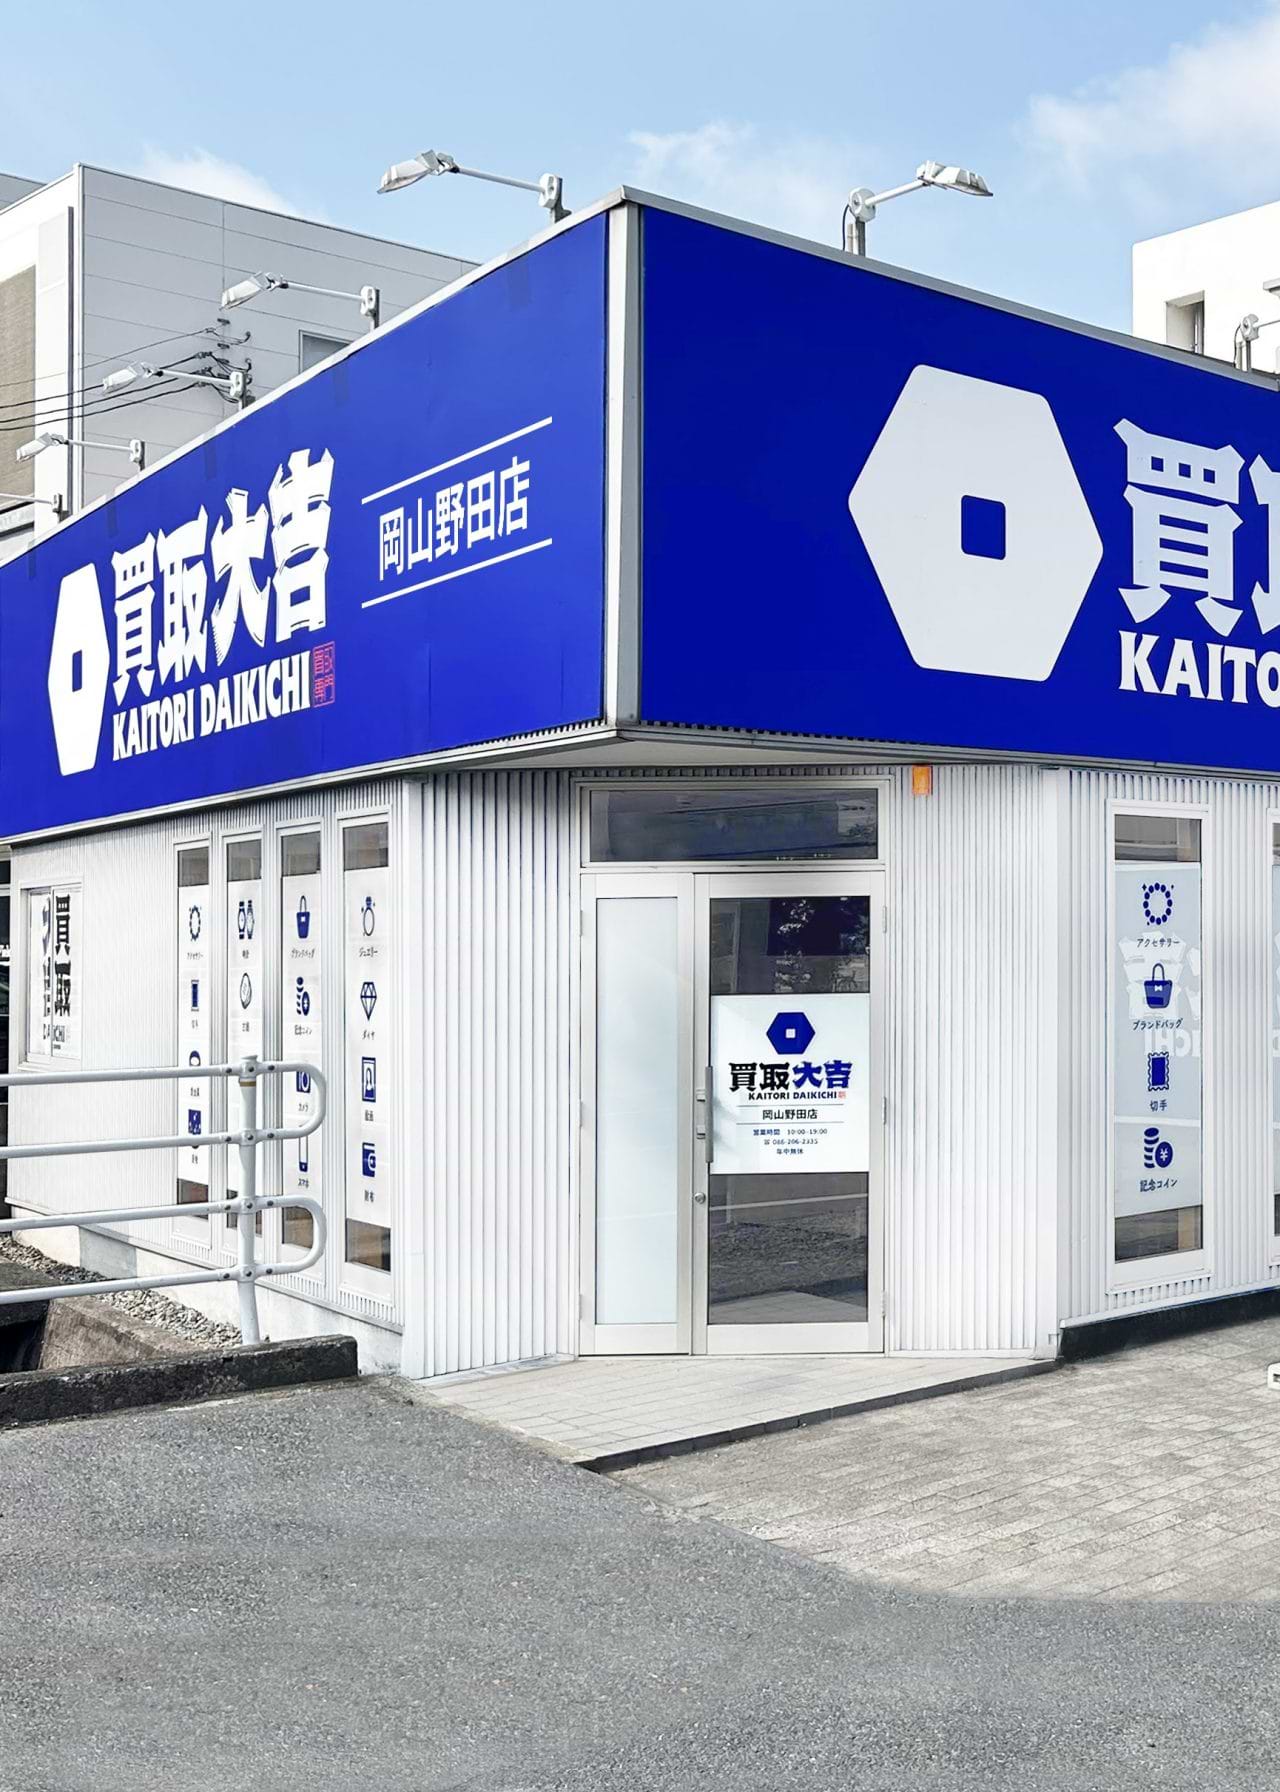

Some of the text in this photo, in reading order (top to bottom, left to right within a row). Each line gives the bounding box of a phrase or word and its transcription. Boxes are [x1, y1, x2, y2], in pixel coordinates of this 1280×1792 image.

[380, 456, 530, 581] 岡山野田店
[111, 448, 334, 706] 買取大吉
[113, 651, 311, 761] KAITORI DAIKICHI
[1136, 938, 1181, 948] アクセサリー
[1132, 1018, 1183, 1031] ブランドバッグ
[728, 1060, 852, 1092] 買取大吉
[748, 1091, 790, 1101] KAITORI
[793, 1090, 837, 1100] DAIKICHI
[1149, 1099, 1167, 1112] 切手
[762, 1109, 818, 1120] 岡山野田店
[1139, 1178, 1178, 1193] 記念コイン
